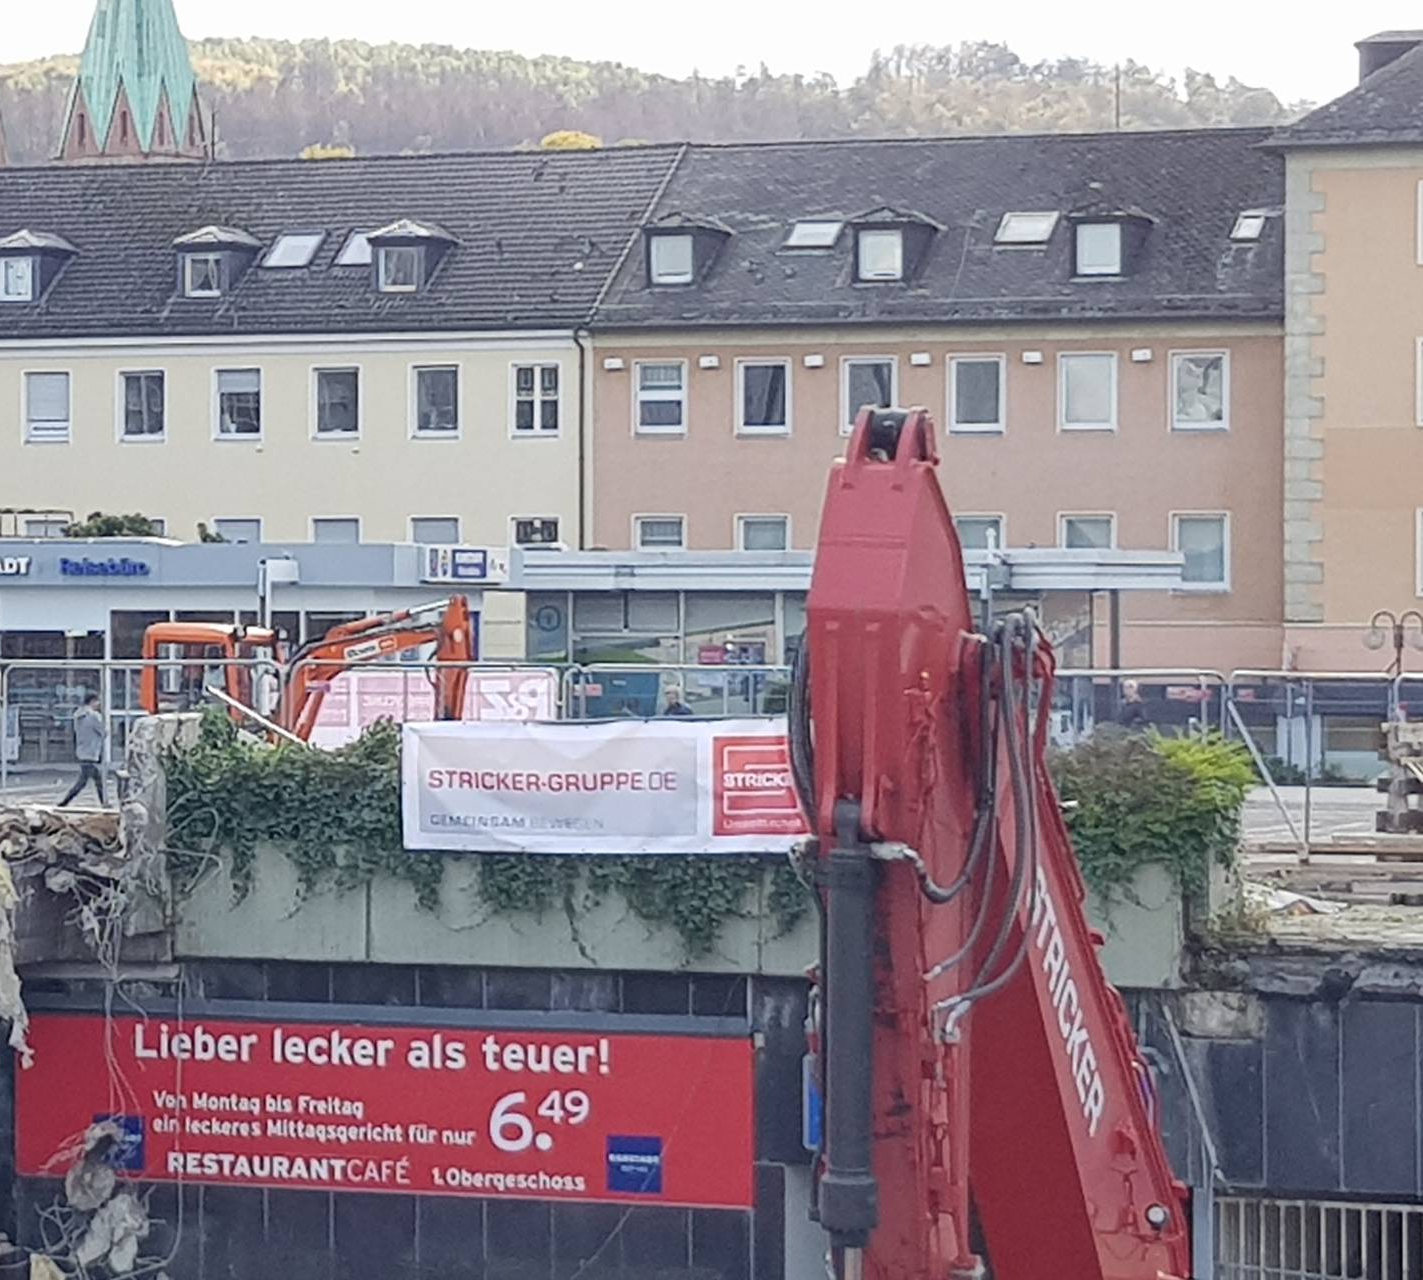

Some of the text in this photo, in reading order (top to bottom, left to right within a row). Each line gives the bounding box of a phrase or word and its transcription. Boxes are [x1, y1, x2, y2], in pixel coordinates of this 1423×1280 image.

[60, 557, 151, 576] Reisebüro
[427, 770, 793, 792] STRICKER-GRUPPE.DE STRICK
[429, 814, 525, 828] GEMEINSAM
[134, 1023, 610, 1075] Lieber lecker als teuer!
[152, 1090, 188, 1109] Von
[192, 1091, 261, 1116] Montag
[265, 1093, 293, 1113] bis
[298, 1095, 364, 1118] Freitag
[152, 1114, 476, 1146] ein leckeres Mittagsgericht für nur
[166, 1151, 411, 1184] RESTAURANTCAFÉ
